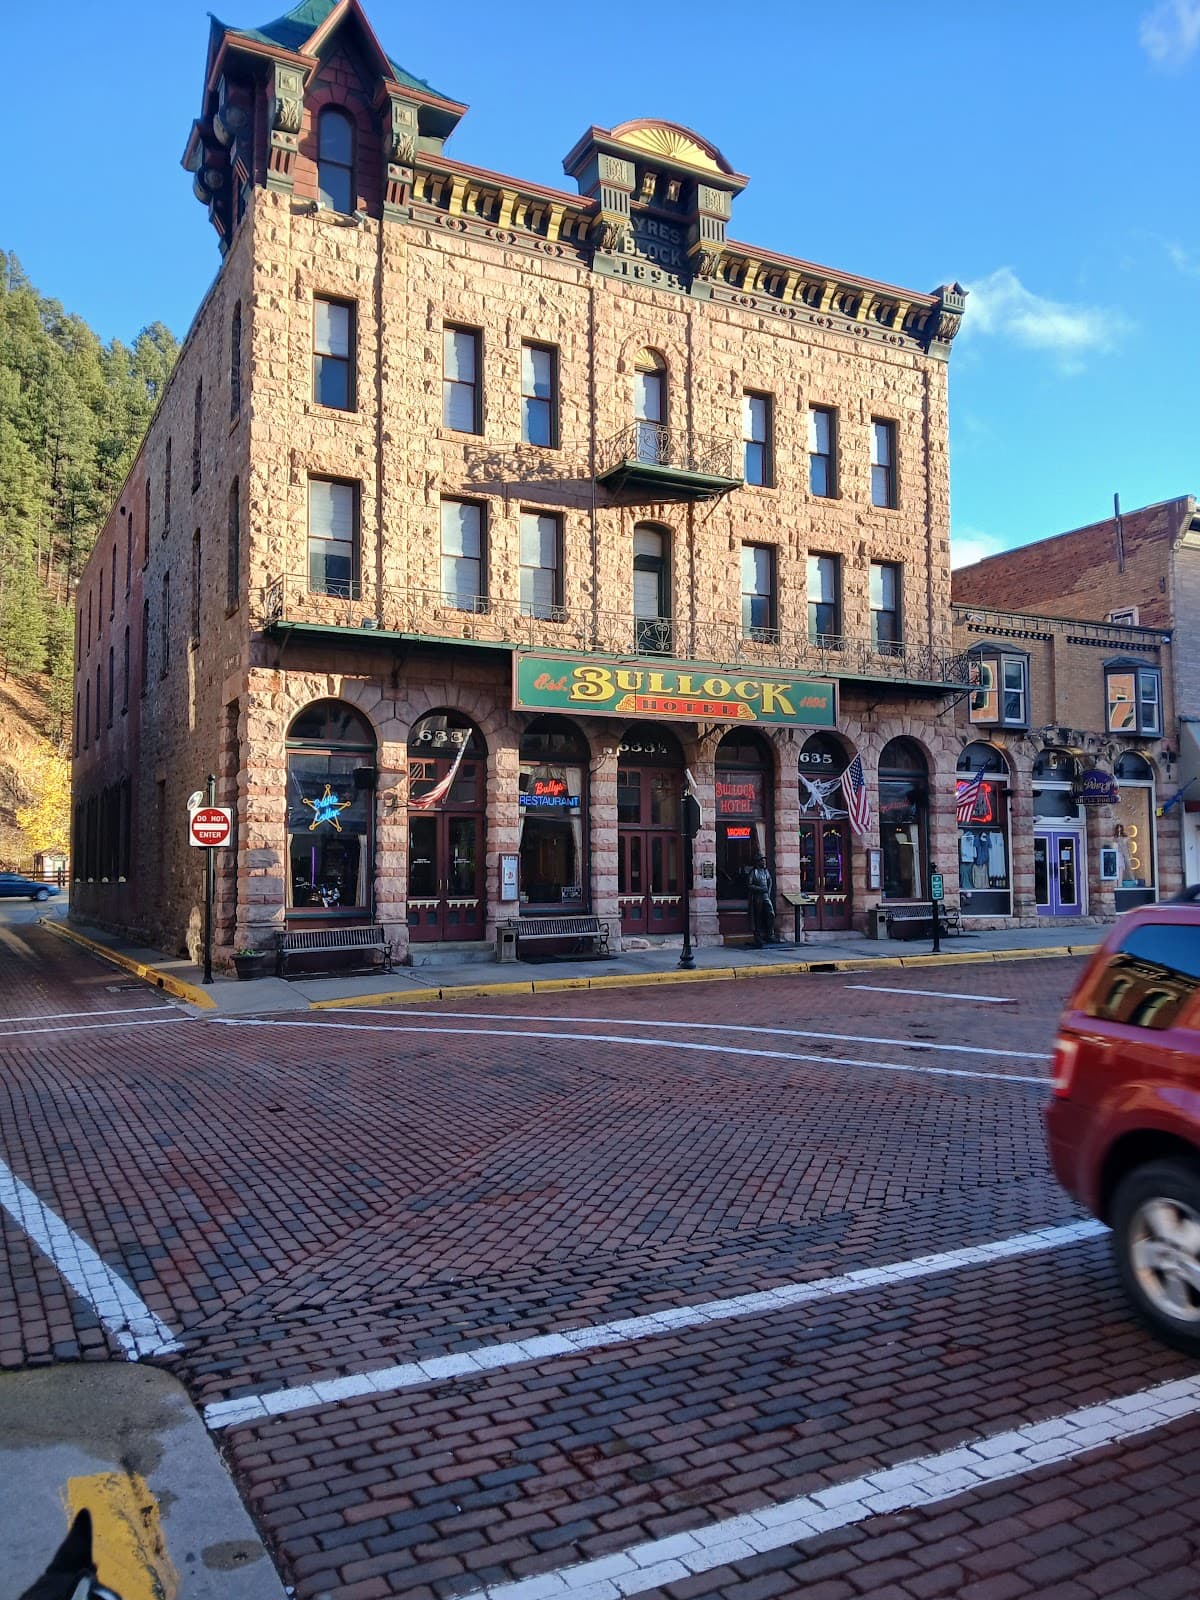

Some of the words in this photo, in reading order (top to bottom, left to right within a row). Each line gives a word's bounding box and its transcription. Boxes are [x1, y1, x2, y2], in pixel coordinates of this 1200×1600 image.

[623, 217, 681, 244] AYRES
[623, 236, 681, 266] BLOCK
[567, 666, 797, 716] BULLOCK
[642, 699, 733, 715] HOTEL
[419, 729, 464, 743] 633
[799, 752, 833, 764] 635
[519, 795, 579, 806] RESTAURANT
[721, 799, 753, 813] HOTEL
[199, 831, 222, 839] ENTER
